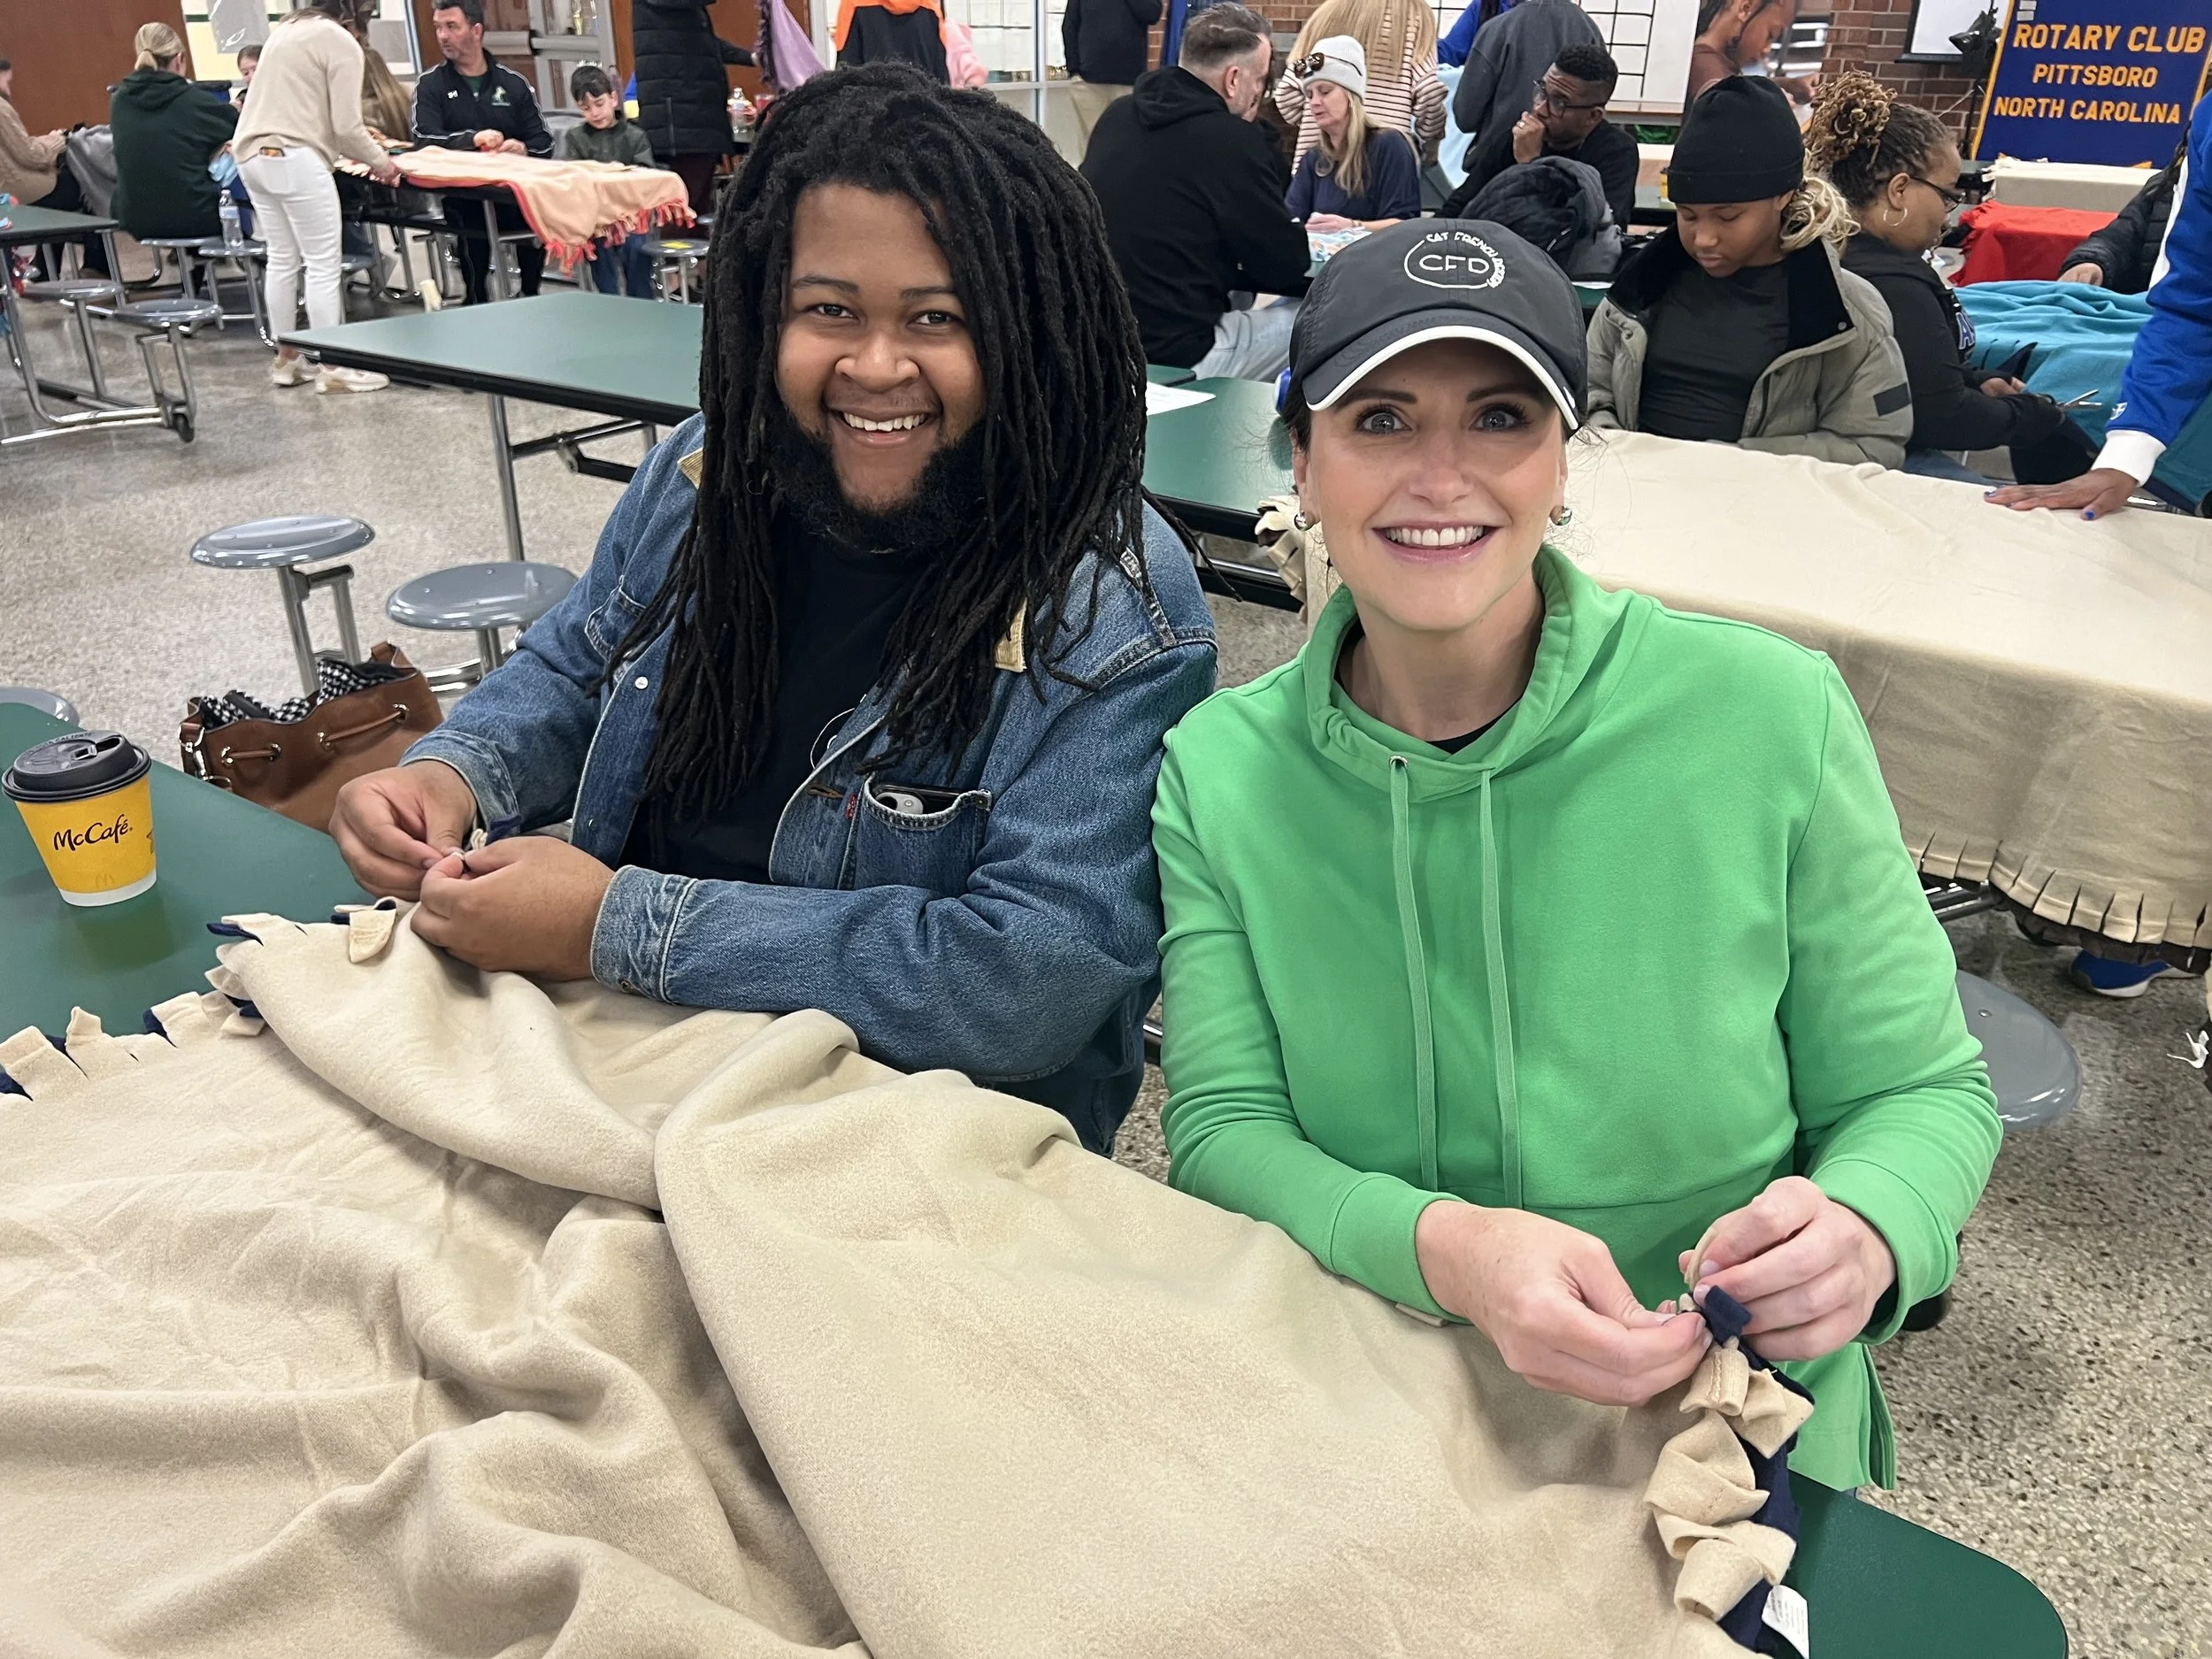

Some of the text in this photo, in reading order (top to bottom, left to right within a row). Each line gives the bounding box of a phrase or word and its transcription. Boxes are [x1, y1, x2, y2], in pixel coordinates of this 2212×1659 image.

[2014, 24, 2206, 53] ROTARY CLUB
[2033, 64, 2158, 87] PITTSBORO
[1993, 96, 2179, 123] NORTH CAROLINA
[1425, 232, 1449, 242] CAT
[1419, 254, 1490, 274] CFD
[53, 813, 129, 851] McCafé
